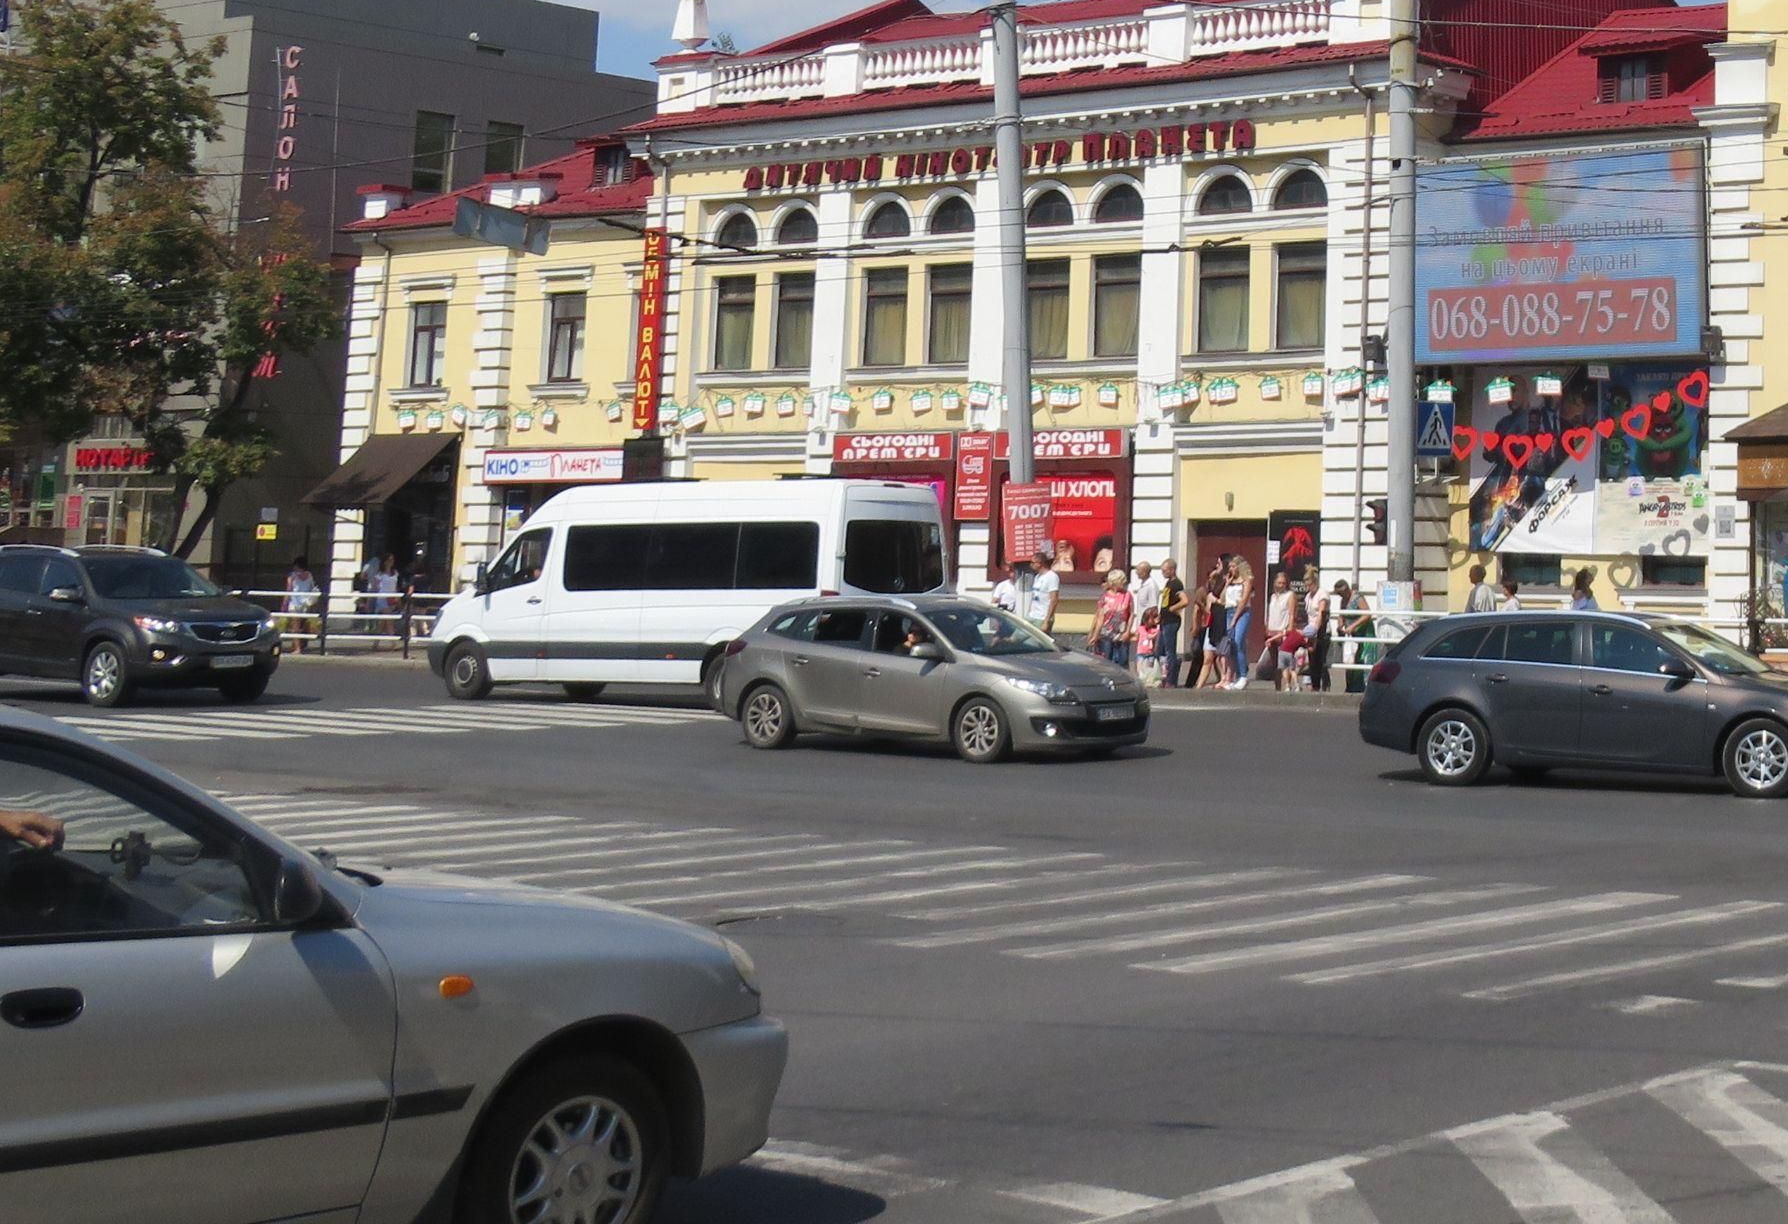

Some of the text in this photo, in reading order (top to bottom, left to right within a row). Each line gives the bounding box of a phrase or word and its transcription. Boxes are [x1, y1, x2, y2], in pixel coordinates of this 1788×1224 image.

[276, 45, 304, 192] САЛОН
[744, 153, 883, 190] ДИТЯЧИЙ
[1083, 118, 1256, 163] ПЛАНЕТА
[1540, 216, 1664, 248] привітання
[1461, 248, 1640, 281] на цьому екрані
[1431, 287, 1671, 340] 068-088-75-78
[637, 327, 654, 416] ВАЛЮТ
[851, 435, 935, 448] СЬОГОДНІ
[486, 458, 519, 476] КІНО
[1008, 504, 1051, 520] 7007
[1528, 473, 1577, 534] ФОРСАЖ
